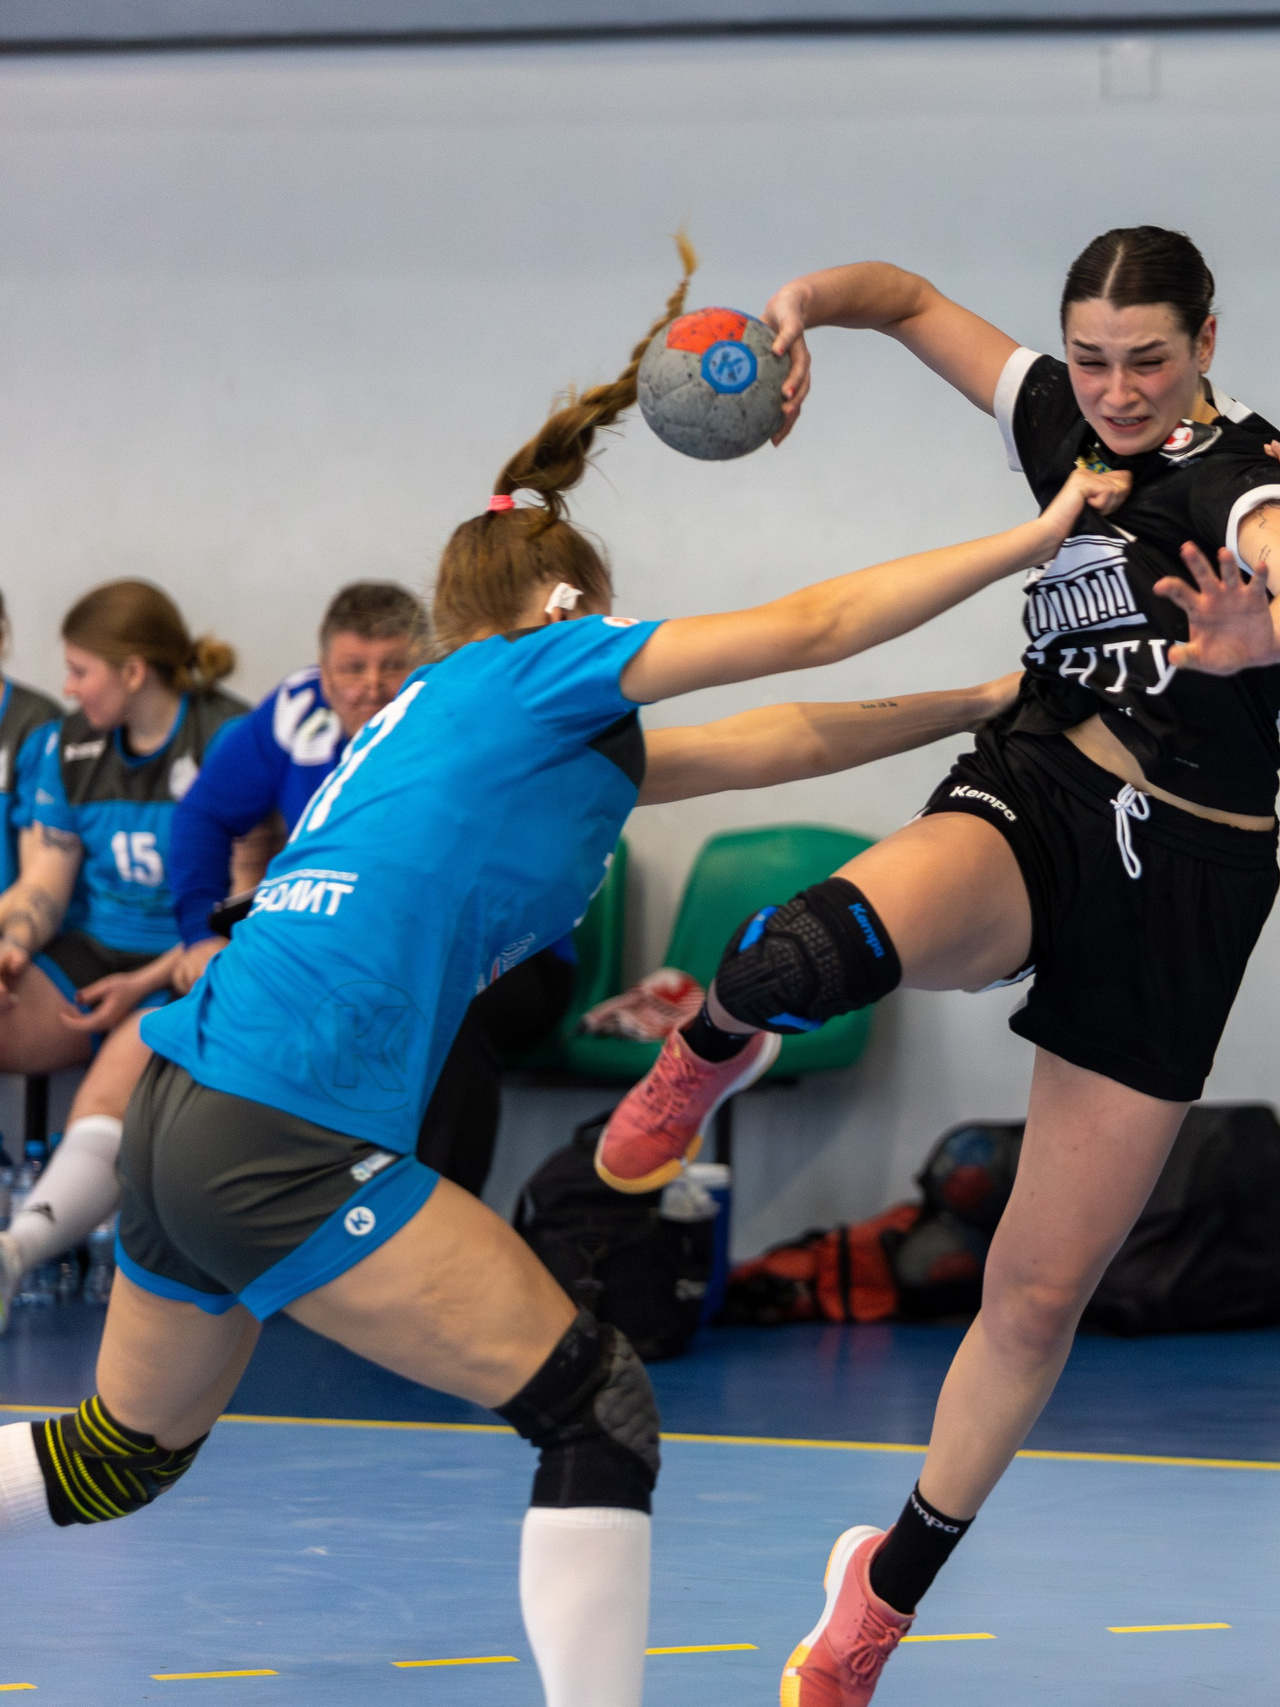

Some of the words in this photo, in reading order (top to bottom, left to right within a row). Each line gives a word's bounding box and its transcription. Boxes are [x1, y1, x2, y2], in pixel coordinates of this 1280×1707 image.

[1026, 639, 1187, 695] НТУ
[949, 785, 1017, 821] Kempa
[111, 831, 165, 887] 15
[848, 902, 885, 958] Kempa
